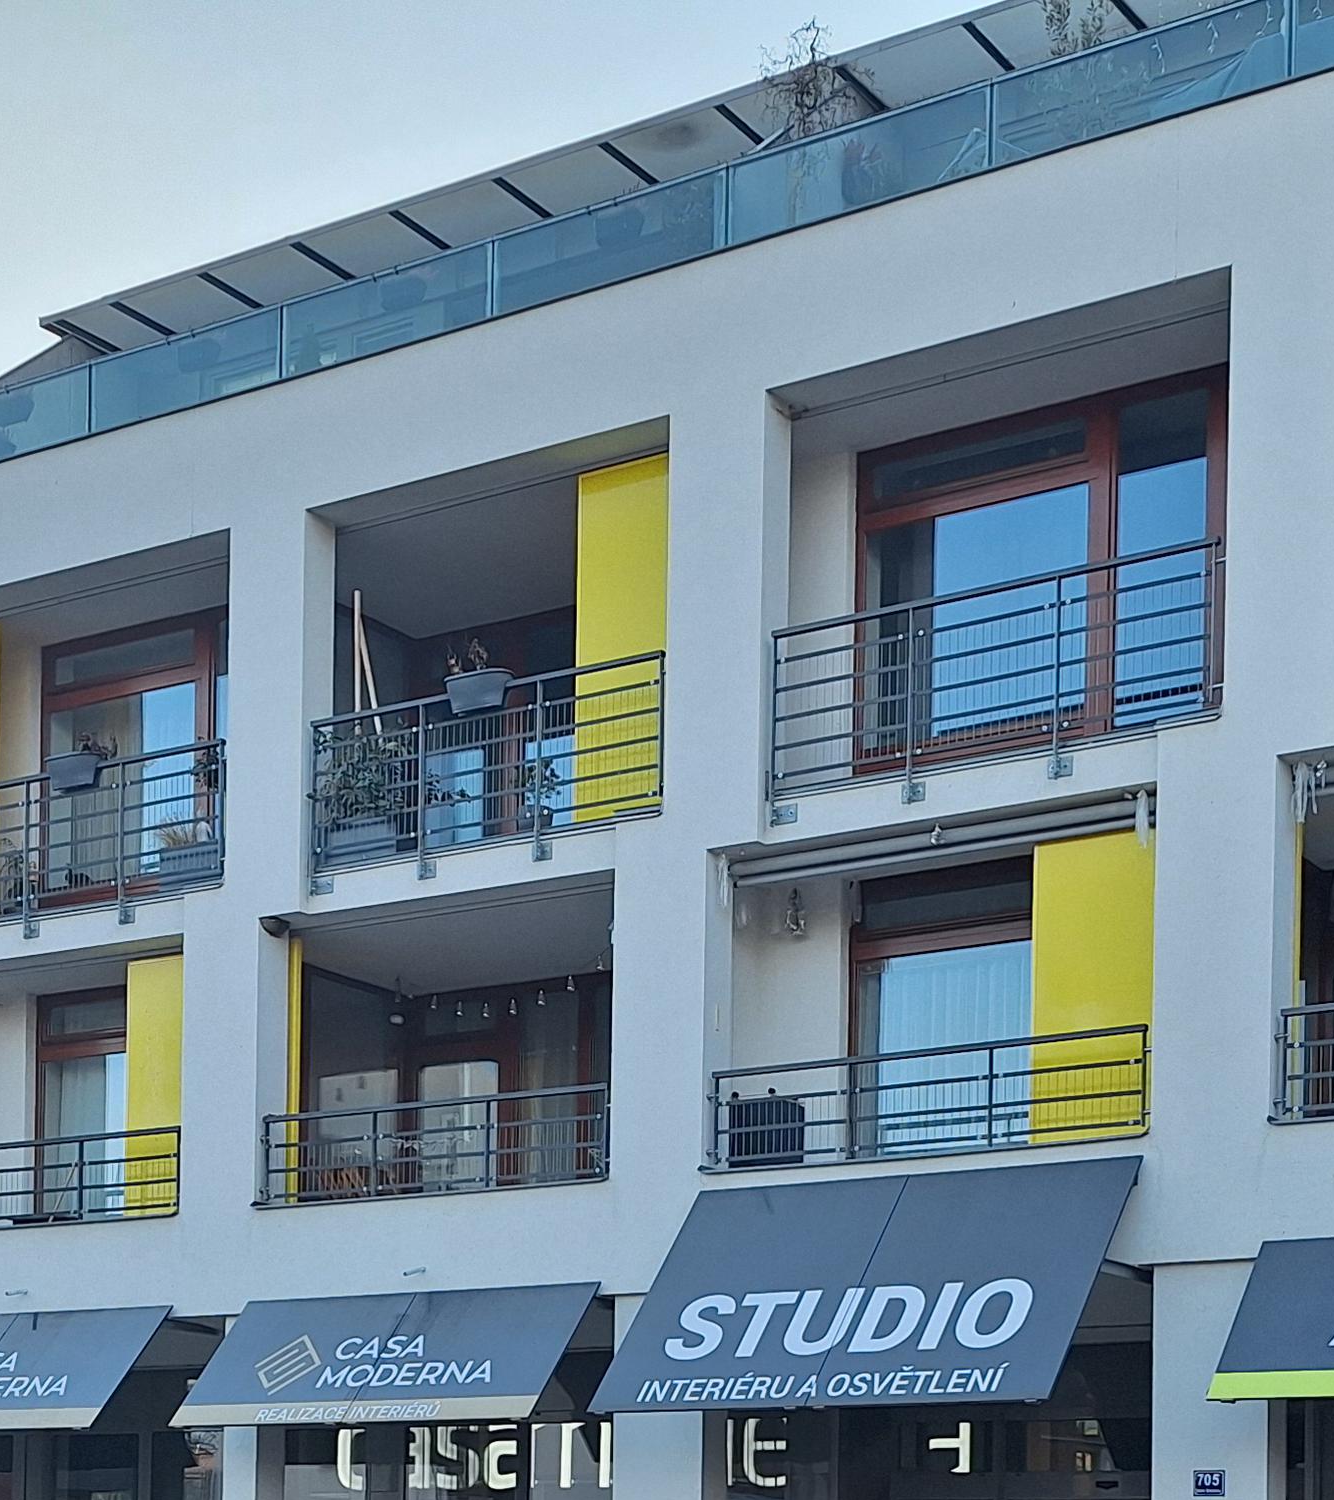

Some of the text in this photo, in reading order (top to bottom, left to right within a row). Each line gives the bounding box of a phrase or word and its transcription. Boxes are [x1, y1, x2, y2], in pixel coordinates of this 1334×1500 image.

[664, 1278, 1034, 1361] STUDIO
[335, 1334, 424, 1360] CASA
[315, 1359, 492, 1389] MODERNA
[636, 1362, 1011, 1402] INTERIÉRU A OSVĚTLENÍ
[254, 1400, 441, 1422] REALIZACE INTERIÉRŮ
[1197, 1473, 1221, 1486] 705
